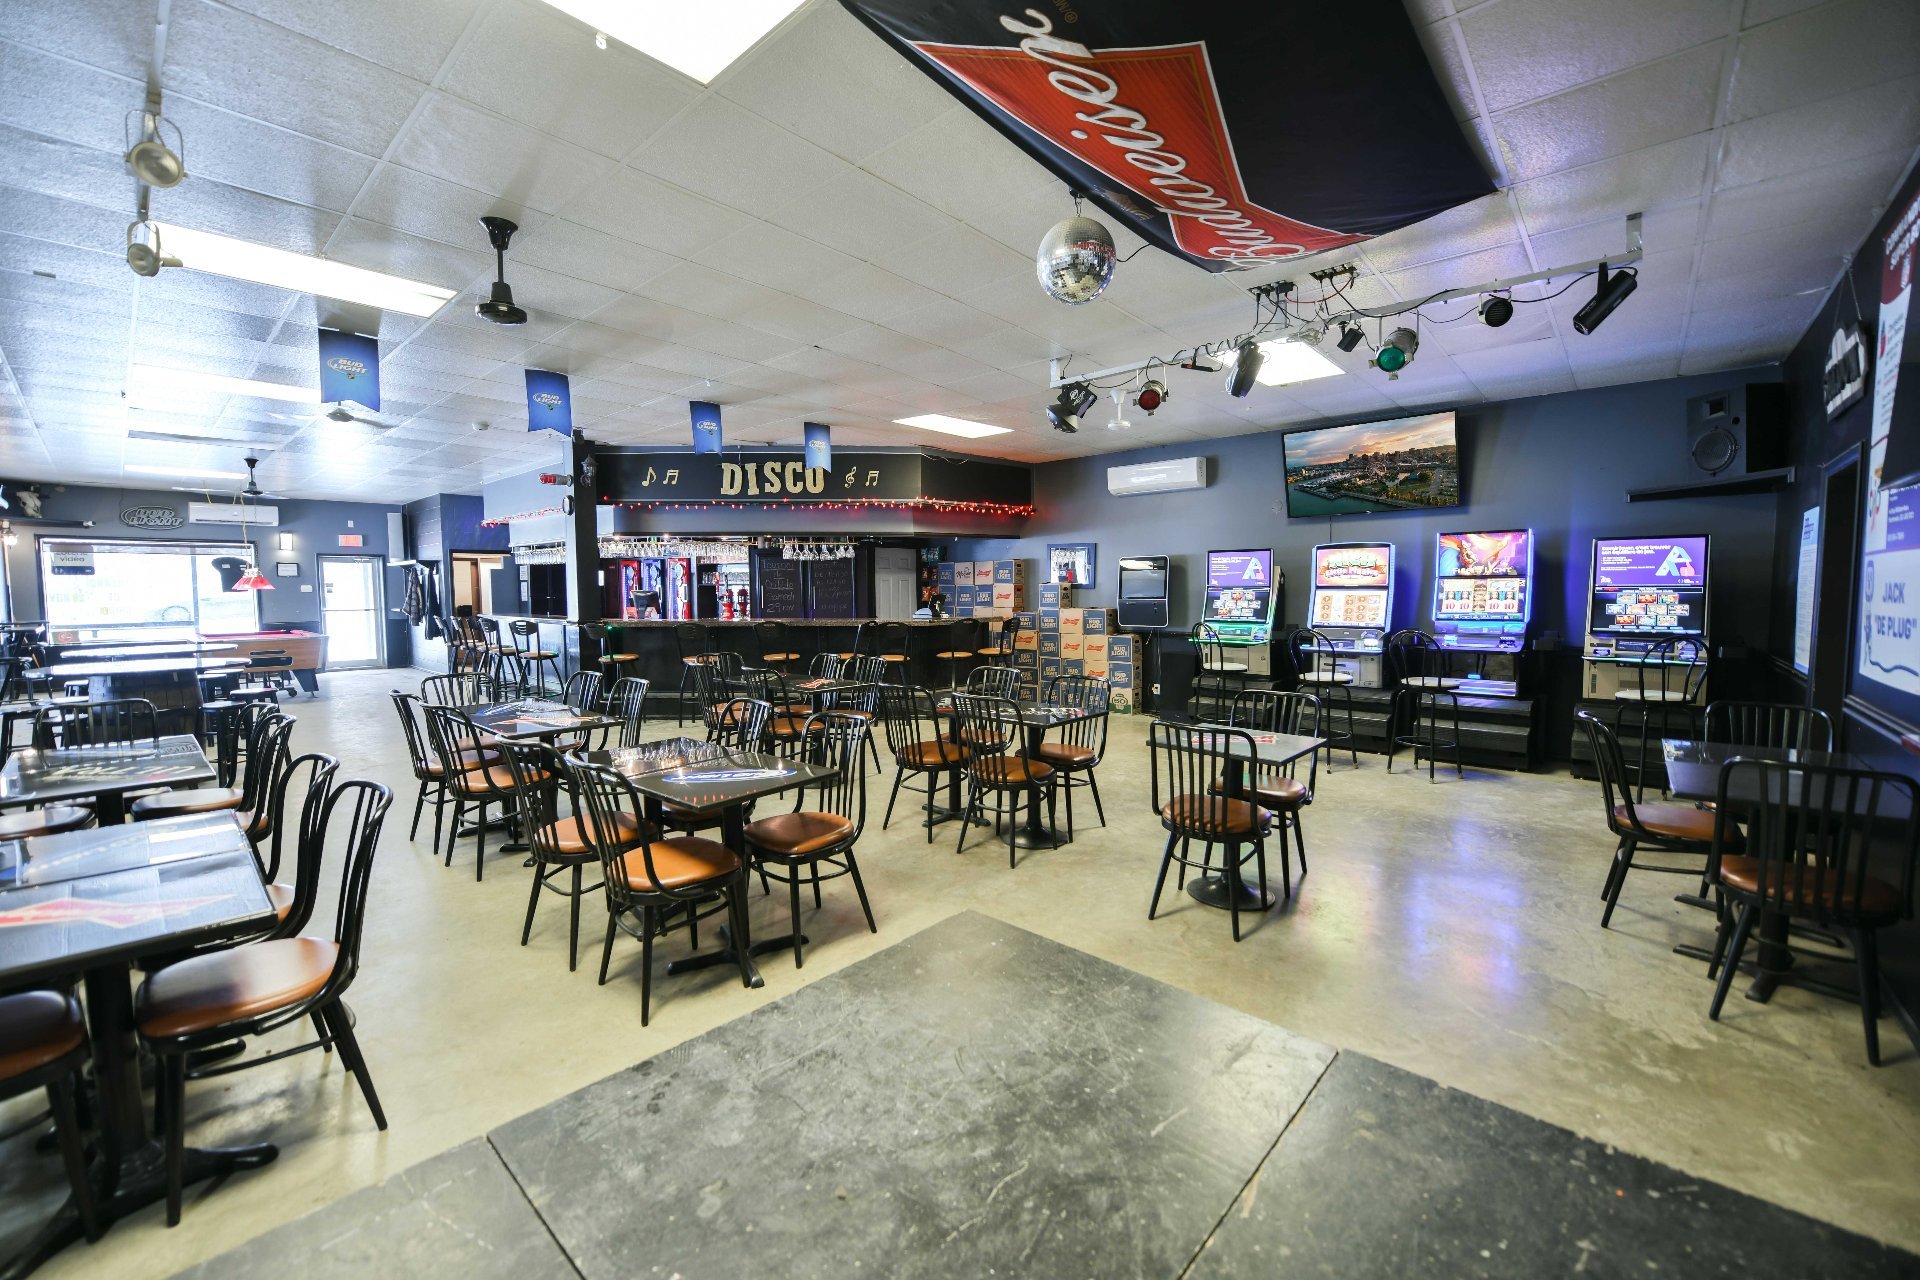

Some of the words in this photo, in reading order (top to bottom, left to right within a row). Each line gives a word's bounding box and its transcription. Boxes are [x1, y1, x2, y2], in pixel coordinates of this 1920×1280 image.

[1000, 8, 1306, 269] Budweiser
[337, 358, 364, 369] BUD
[333, 364, 368, 375] LIGHT
[535, 397, 563, 406] LIGHT
[540, 393, 560, 401] BUD
[720, 461, 825, 496] DISCO
[136, 508, 175, 519] BUD
[128, 516, 184, 526] LIGHT
[1882, 582, 1906, 604] JACK
[1874, 614, 1886, 635] "DE
[1887, 616, 1917, 640] PLUG"
